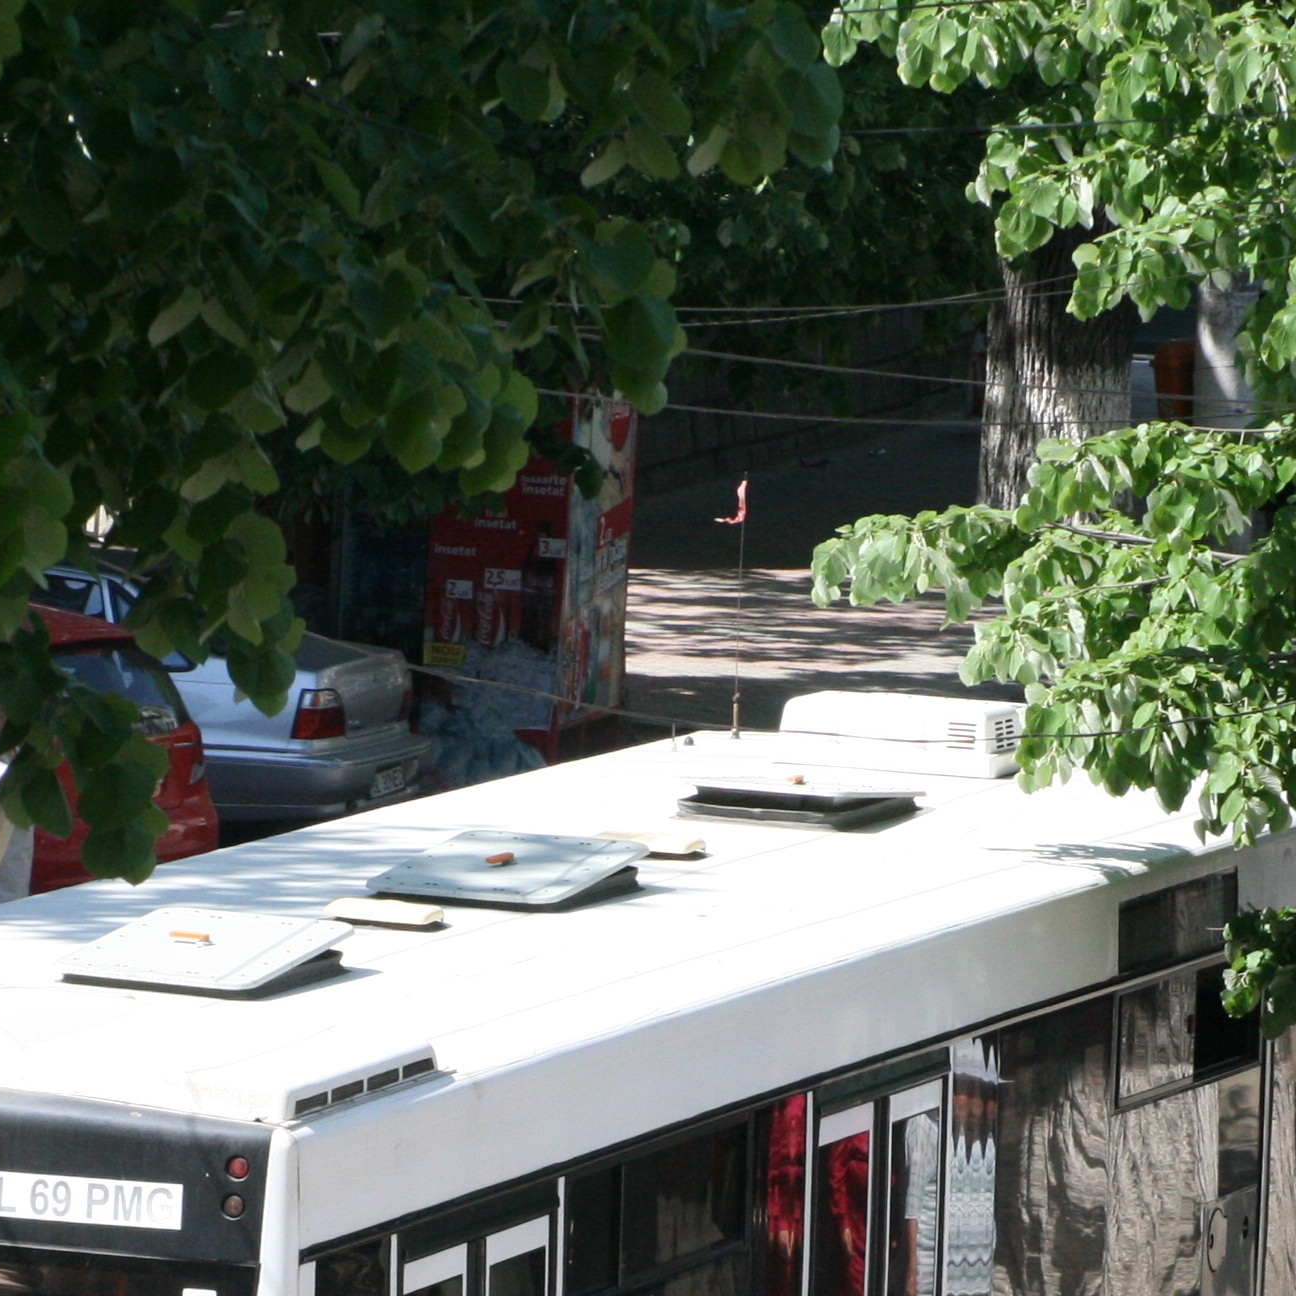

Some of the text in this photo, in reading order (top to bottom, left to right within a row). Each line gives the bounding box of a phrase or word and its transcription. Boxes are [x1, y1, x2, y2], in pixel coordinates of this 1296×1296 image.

[541, 540, 550, 554] 3
[448, 581, 456, 595] 2
[30, 1179, 71, 1217] 69
[86, 1182, 173, 1225] PMG
